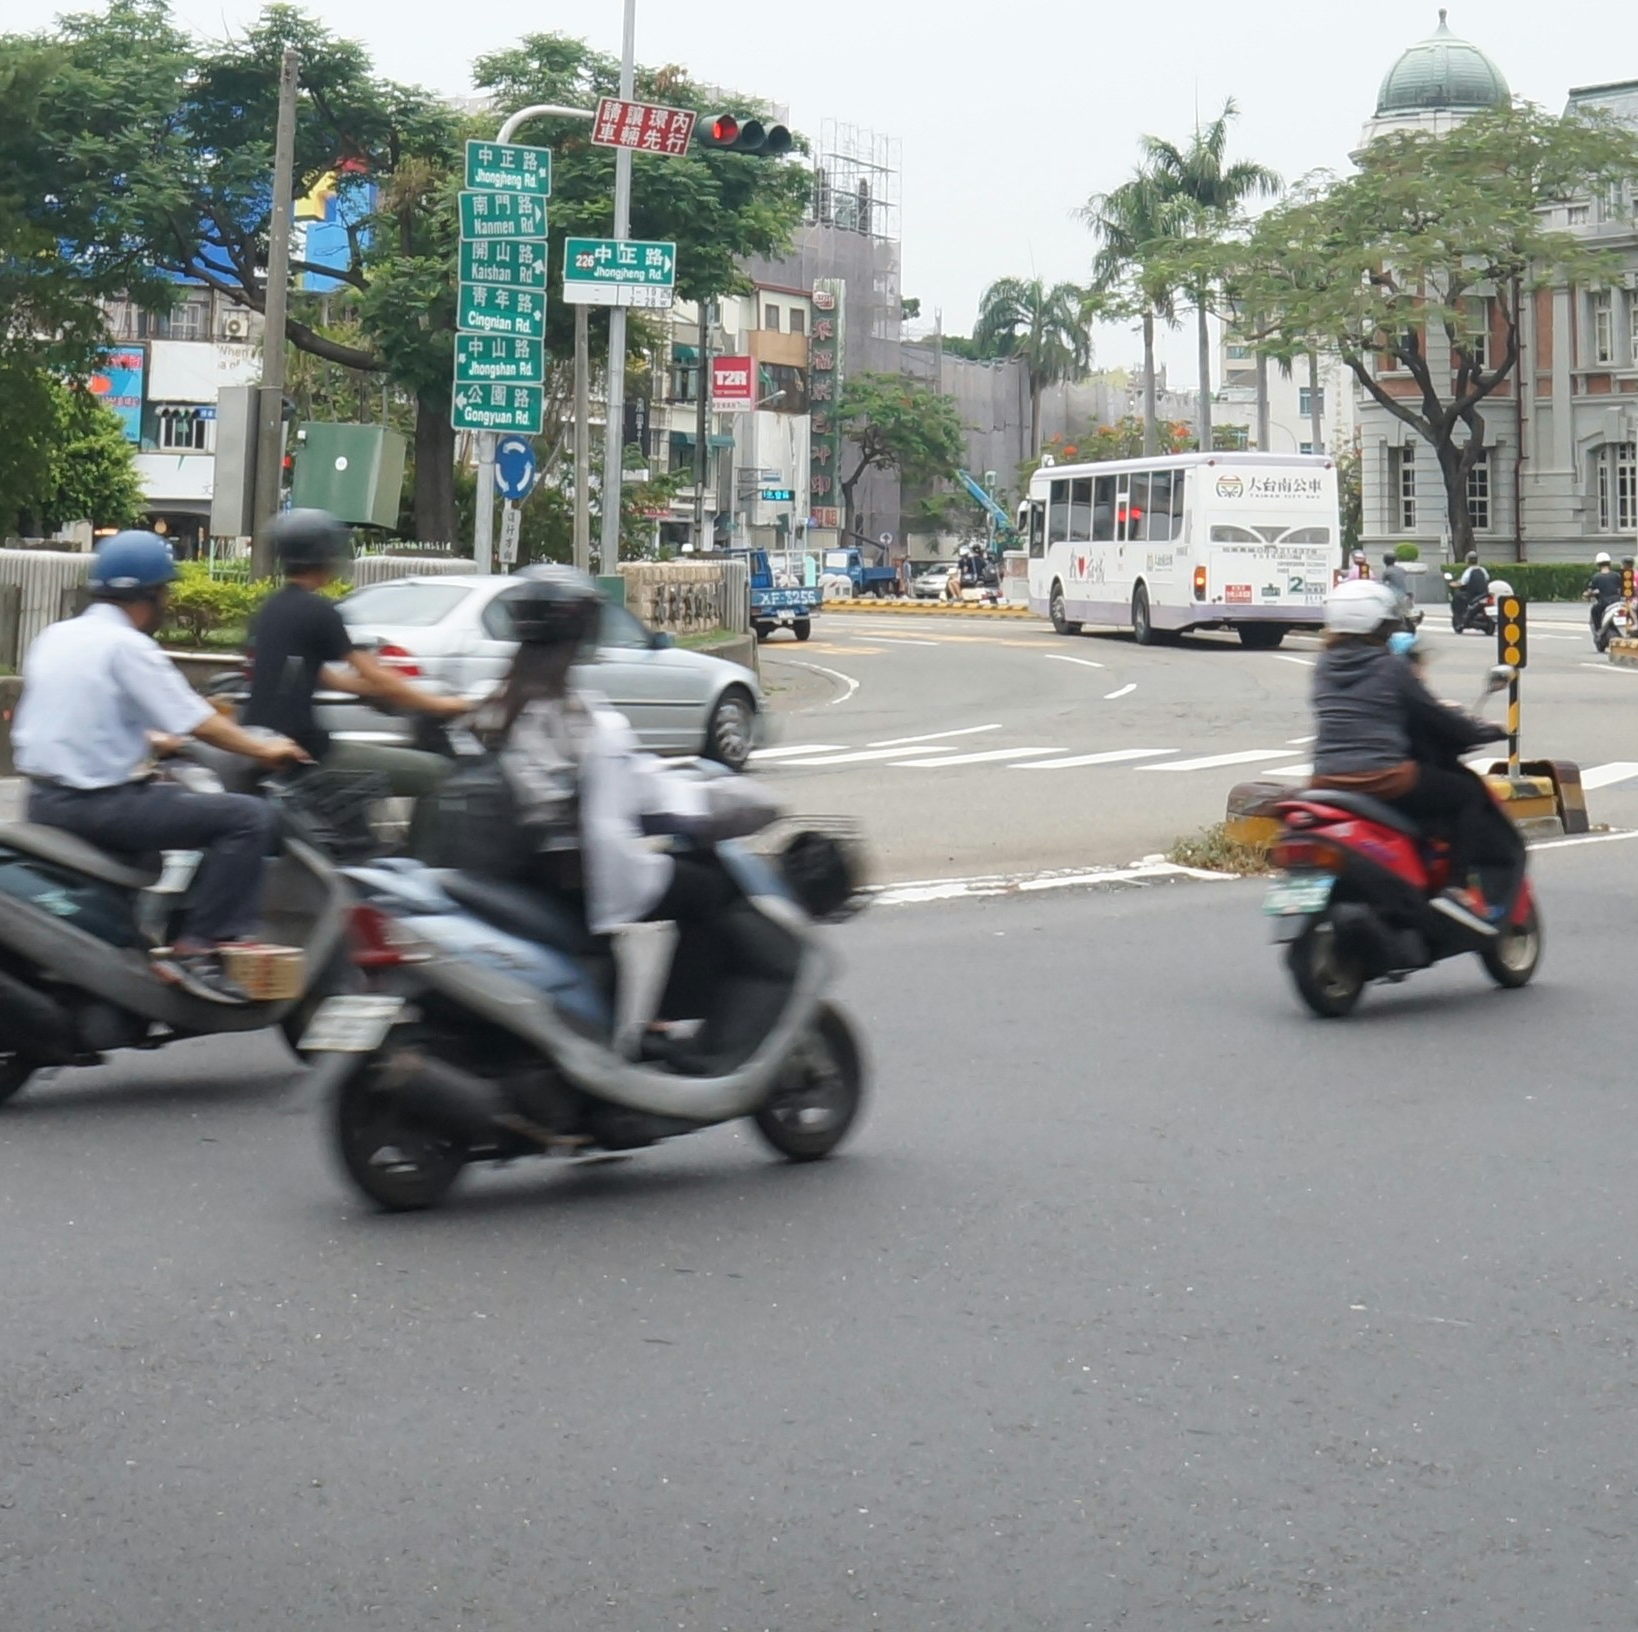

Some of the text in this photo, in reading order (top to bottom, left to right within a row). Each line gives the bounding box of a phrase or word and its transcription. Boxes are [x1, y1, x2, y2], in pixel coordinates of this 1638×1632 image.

[602, 100, 691, 134] 請讓環內
[597, 122, 686, 153] 車輛先行
[478, 145, 538, 171] 中正路
[475, 168, 522, 190] Jhongjheng
[472, 194, 534, 216] 南門路
[474, 218, 515, 235] Nanmen
[472, 241, 534, 264] 開山路
[575, 244, 663, 268] 226 中正路
[471, 264, 512, 282] Kaishan
[593, 266, 645, 282] Jhongjheng
[472, 286, 533, 314] 青年路
[467, 309, 512, 332] Cingnian
[468, 336, 530, 359] 中山路
[468, 360, 516, 379] Jhongshan
[468, 384, 530, 408] 公園路
[464, 406, 513, 425] Gongyuan
[1248, 476, 1322, 493] 大台南公車
[1289, 576, 1304, 593] 2
